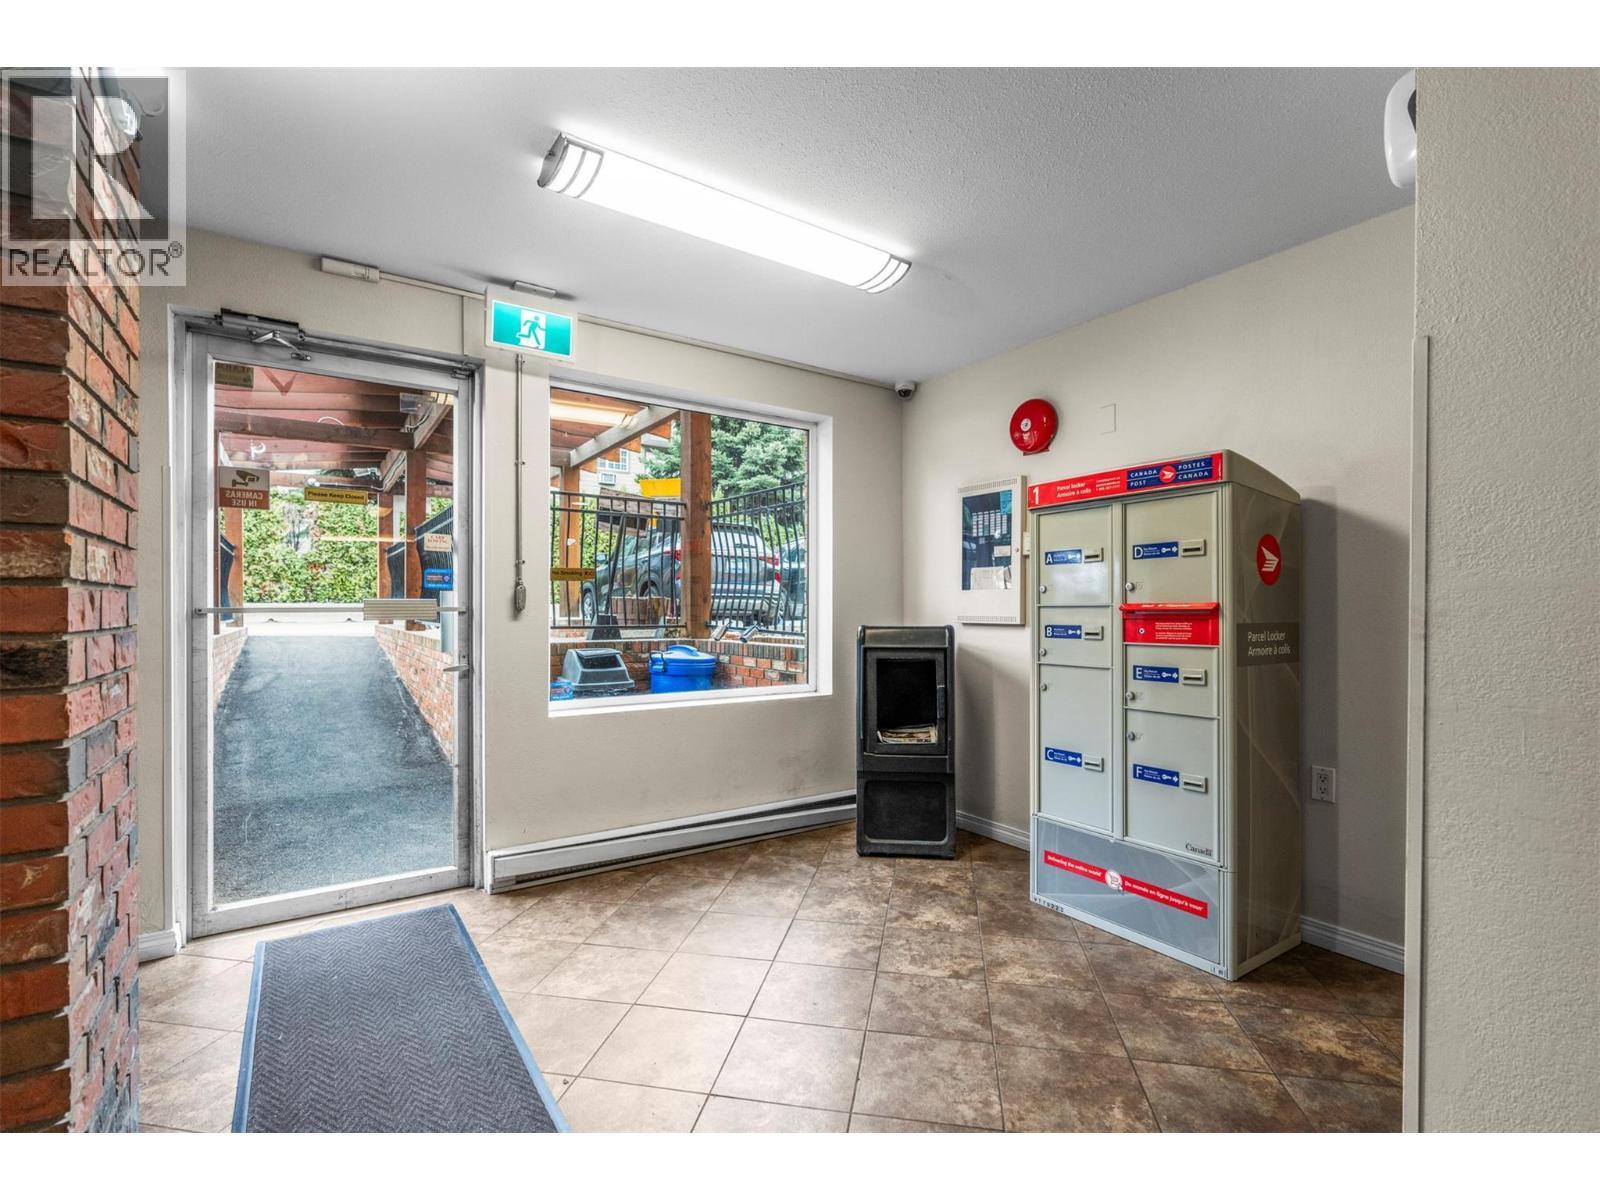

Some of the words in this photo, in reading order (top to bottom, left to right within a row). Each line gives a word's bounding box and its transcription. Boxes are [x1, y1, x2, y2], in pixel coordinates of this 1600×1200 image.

[1178, 461, 1206, 471] POSTES
[1130, 469, 1158, 478] CANADA
[1178, 471, 1209, 480] CANADA
[1056, 484, 1071, 492] Parcel
[1032, 486, 1040, 505] 1
[1134, 546, 1143, 558] D
[1045, 553, 1053, 564] A
[1046, 626, 1052, 637] B
[1248, 631, 1266, 642] Parcel
[1248, 645, 1273, 656] Armoire
[1135, 667, 1143, 679] E
[1046, 749, 1054, 760] C
[1136, 766, 1143, 778] F
[1185, 842, 1212, 856] Canada
